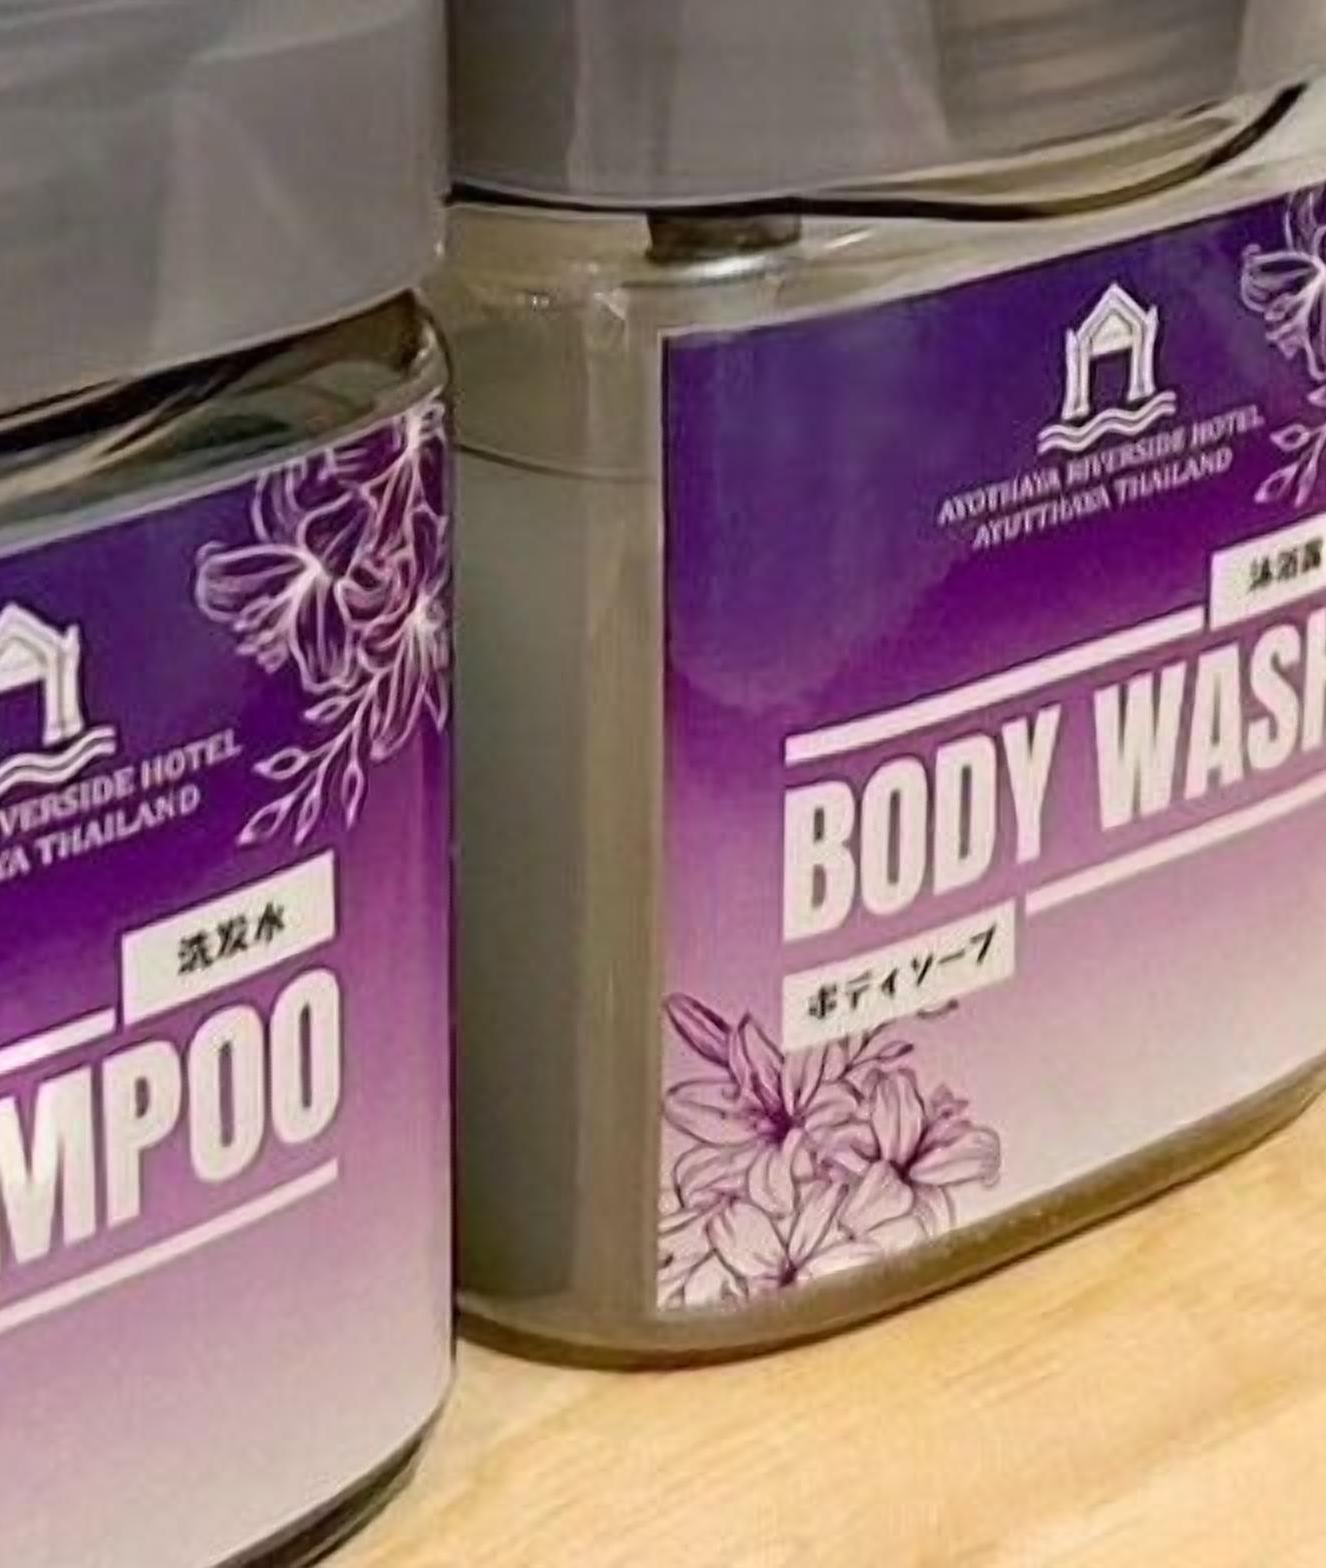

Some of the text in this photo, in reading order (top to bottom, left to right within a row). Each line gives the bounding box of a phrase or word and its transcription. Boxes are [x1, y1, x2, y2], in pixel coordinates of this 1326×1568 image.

[937, 404, 1265, 525] AYOTHAYA RIVERSIDE HOTEL
[973, 446, 1233, 549] AYUTTHAYA THAILAND
[140, 728, 243, 789] HOTEL
[35, 783, 201, 865] THAILAND
[783, 703, 1062, 942] BODY
